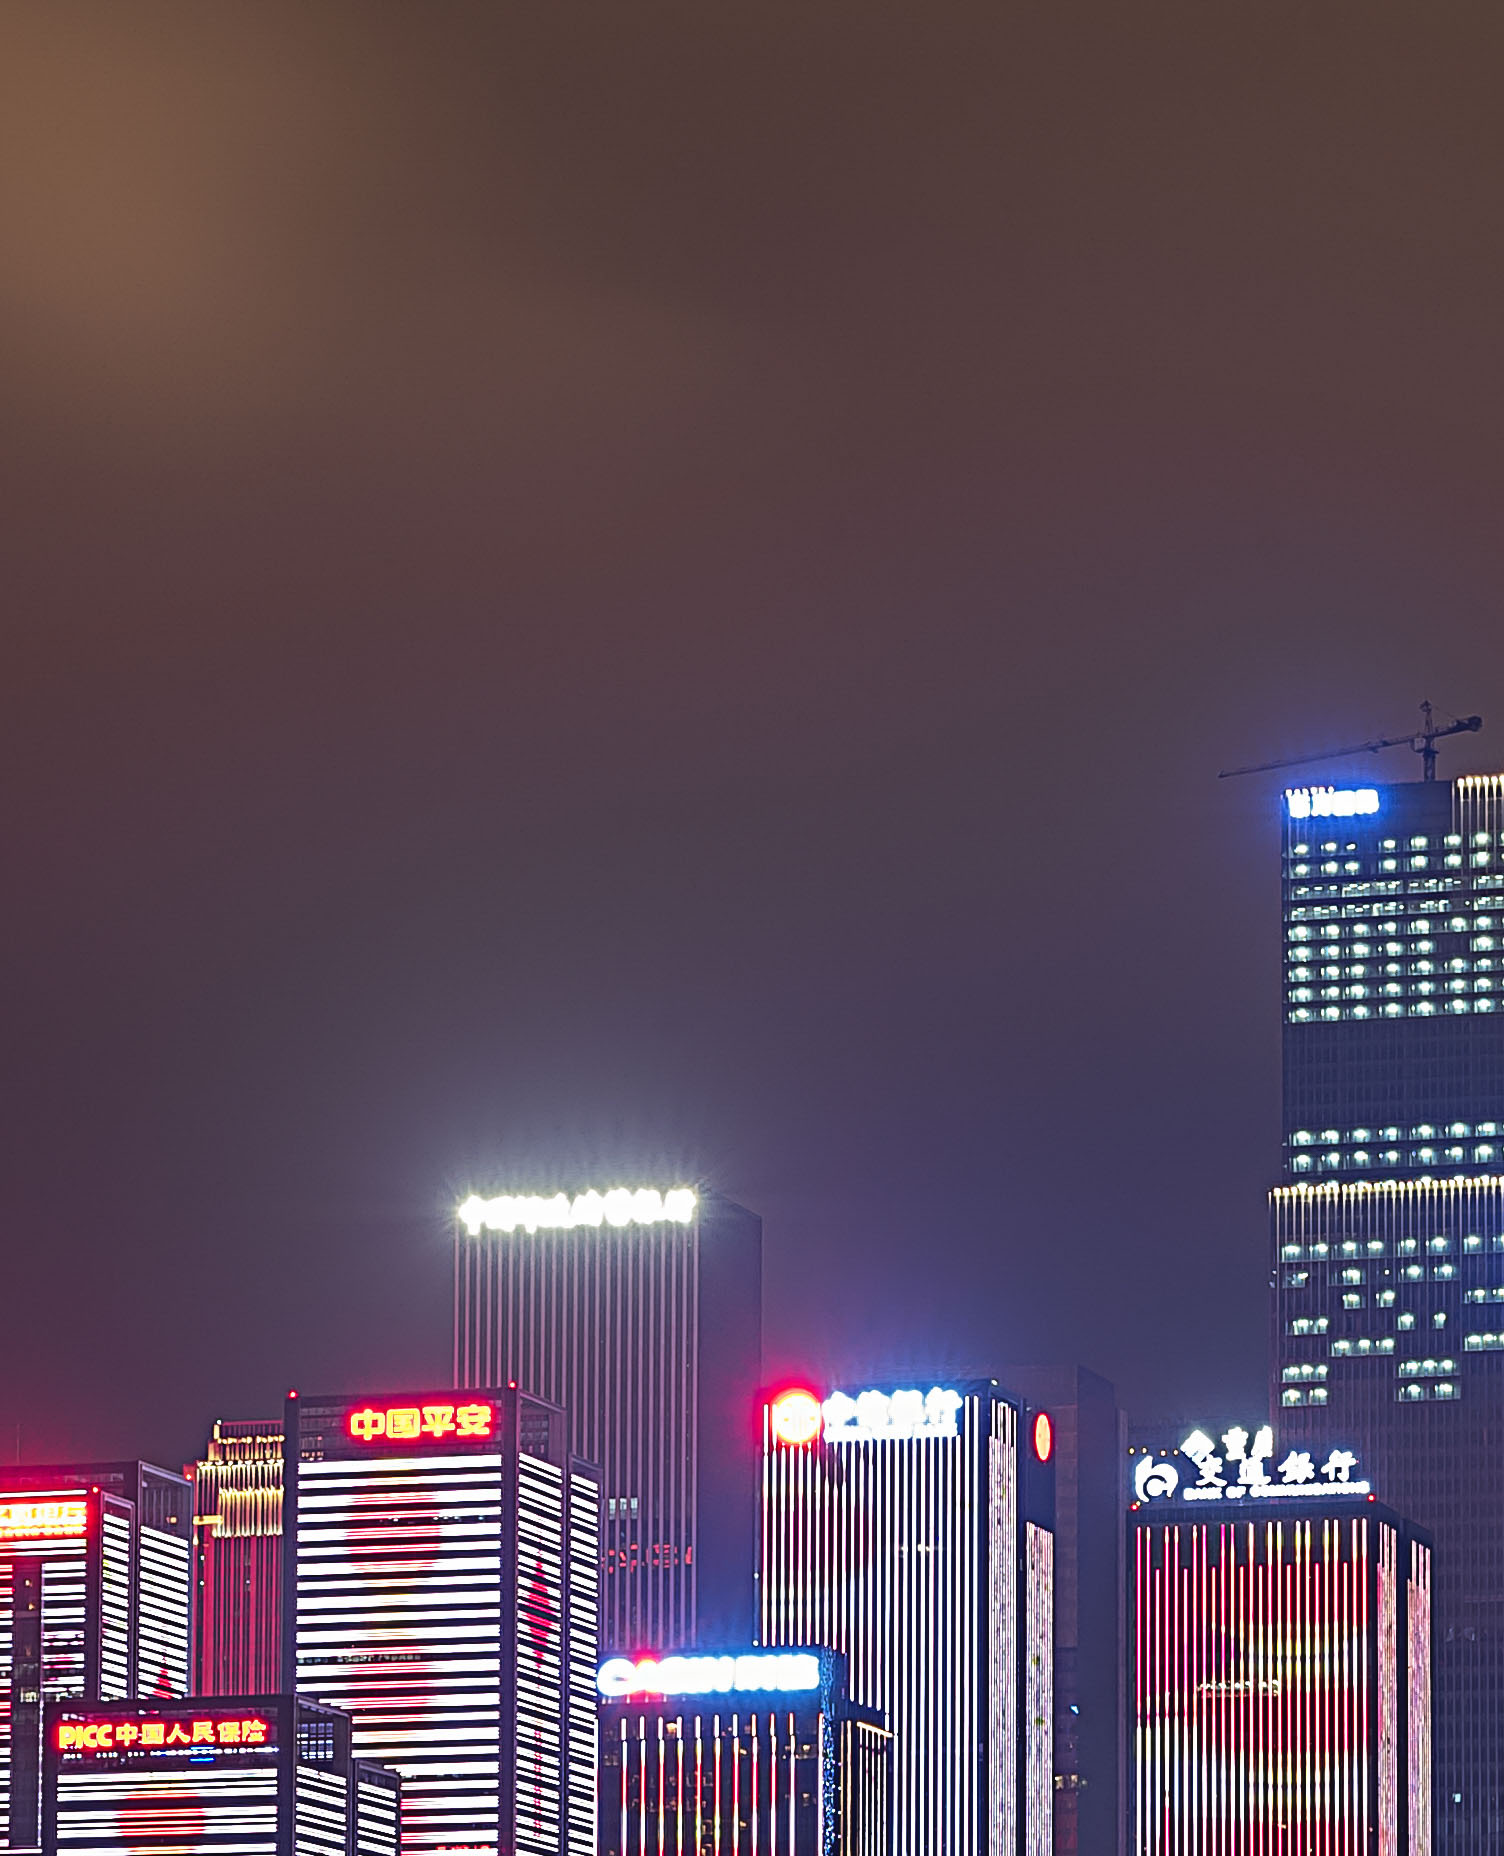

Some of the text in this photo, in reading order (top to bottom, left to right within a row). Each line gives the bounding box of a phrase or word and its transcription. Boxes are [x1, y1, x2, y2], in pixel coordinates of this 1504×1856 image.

[350, 1403, 492, 1441] 中国平安
[1195, 1449, 1358, 1487] 交通银行
[115, 1719, 267, 1747] 中国人民保险
